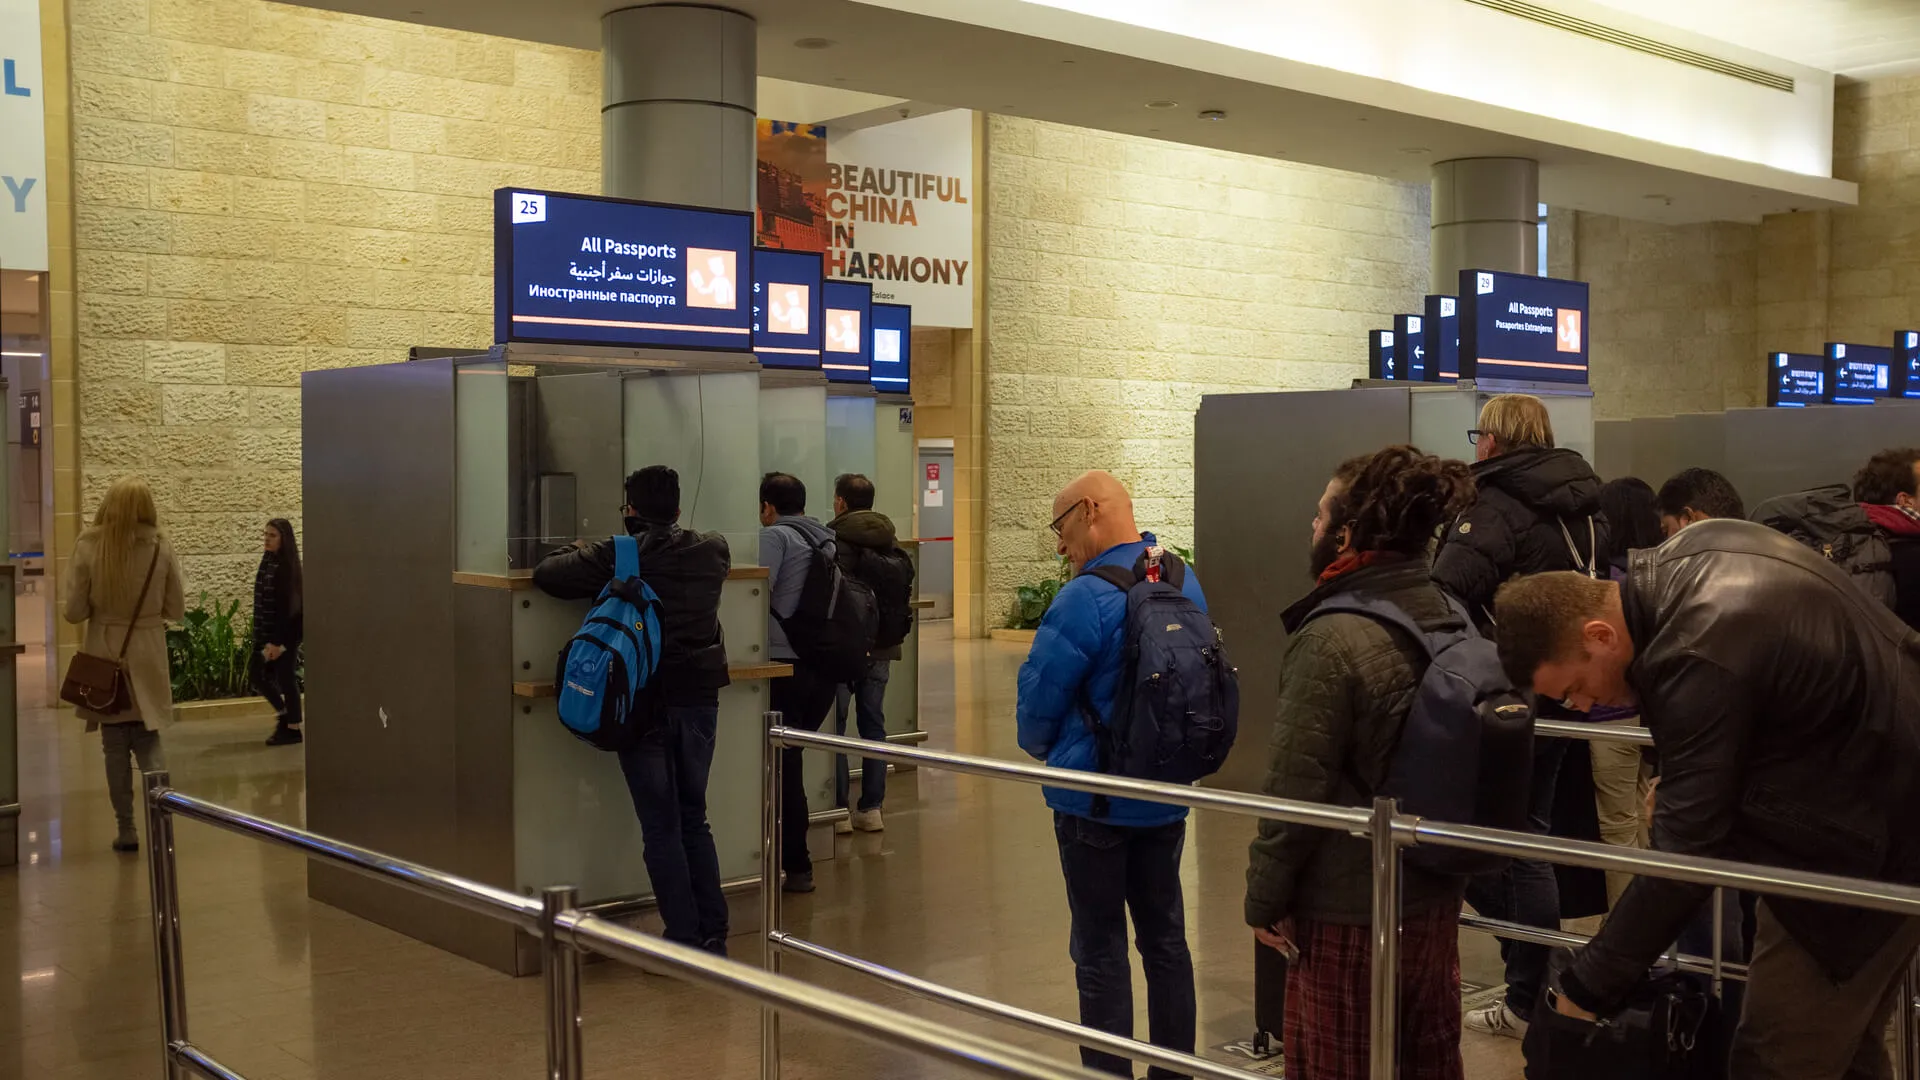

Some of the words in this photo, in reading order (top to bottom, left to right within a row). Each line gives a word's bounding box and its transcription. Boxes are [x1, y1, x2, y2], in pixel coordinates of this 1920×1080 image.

[825, 162, 968, 204] BEAUTIFUL
[520, 200, 538, 215] 25
[826, 191, 918, 227] CHINA
[826, 220, 854, 249] IN
[581, 237, 602, 253] All
[605, 238, 677, 260] Passports
[569, 260, 606, 282] أجنبية
[607, 266, 634, 281] سفر
[636, 268, 677, 287] جوازات
[825, 249, 969, 286] HARMONY
[1481, 277, 1490, 288] 29
[528, 284, 617, 303] Иностранные
[620, 291, 676, 308] паспорта
[1508, 301, 1519, 314] All
[1519, 303, 1553, 318] Passports
